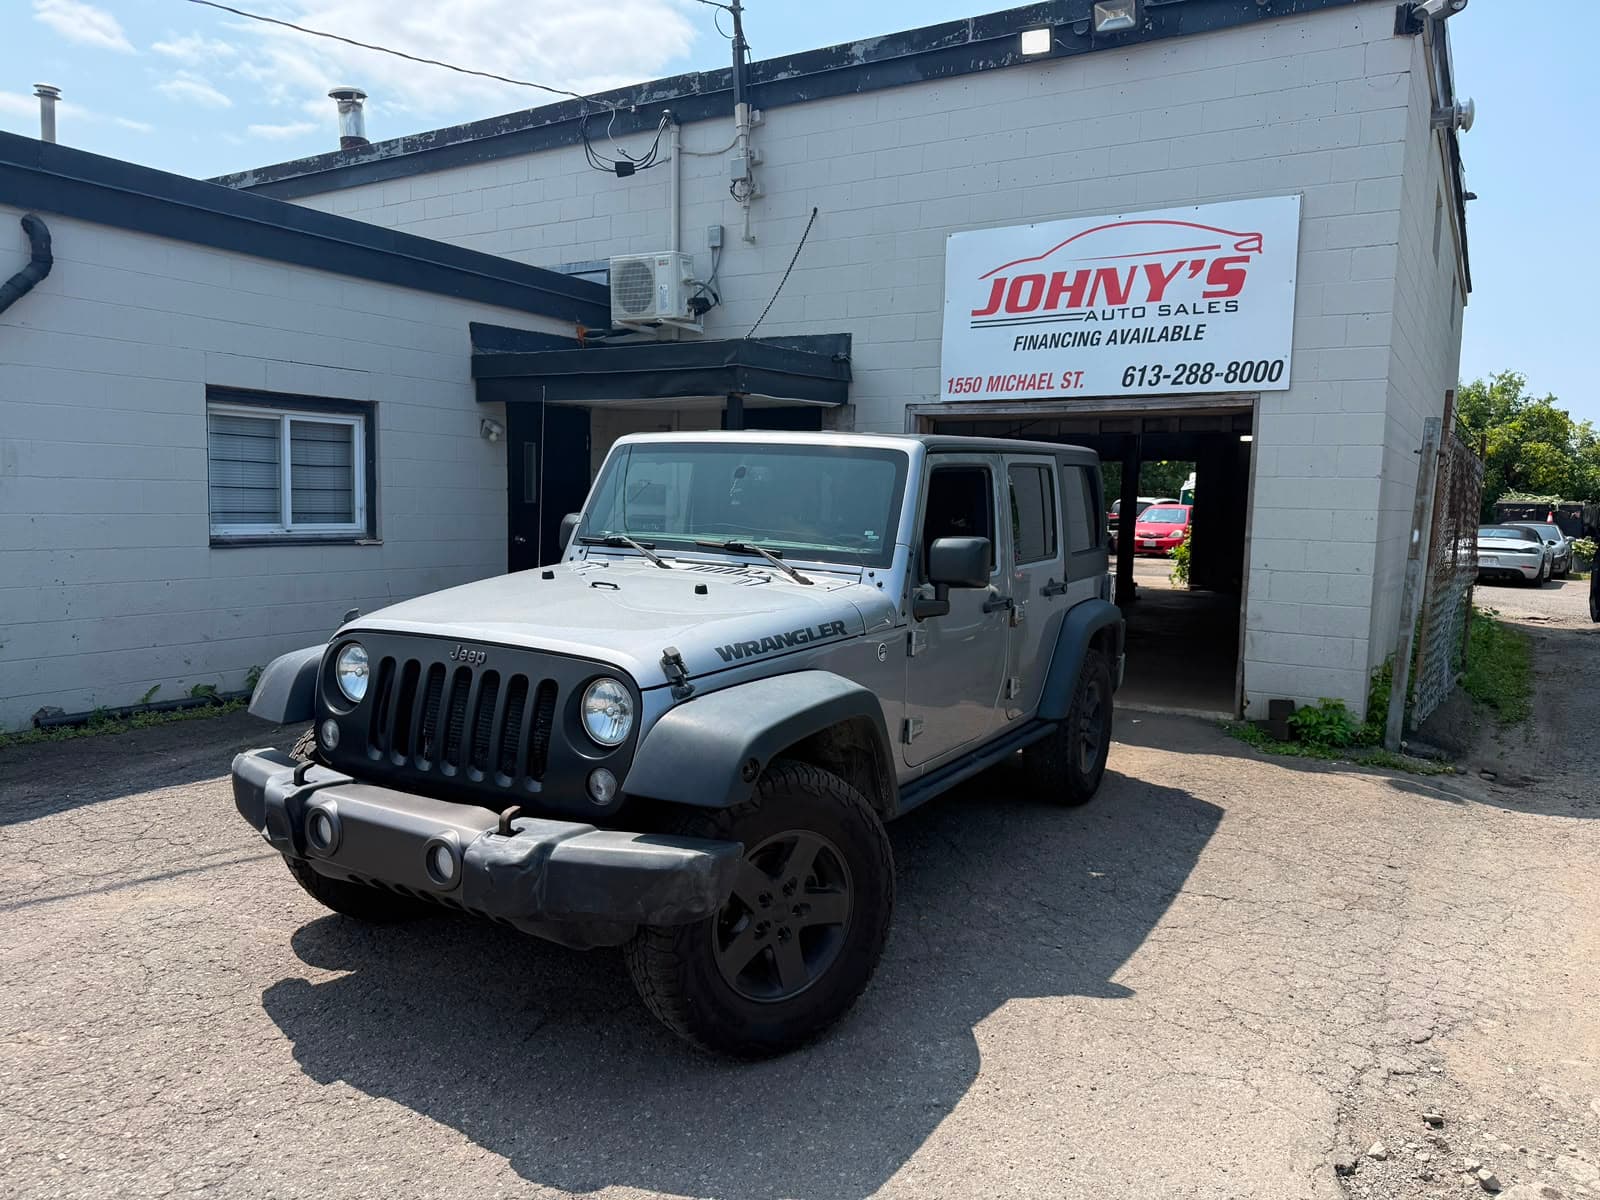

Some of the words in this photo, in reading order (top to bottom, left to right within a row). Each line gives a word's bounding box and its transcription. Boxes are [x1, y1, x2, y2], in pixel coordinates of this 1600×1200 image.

[971, 255, 1251, 317] JOHNY'S
[1084, 306, 1146, 322] AUTO
[1158, 300, 1239, 317] SALES
[1013, 330, 1102, 351] FINANCING
[1105, 323, 1207, 346] AVAILABLE
[947, 376, 983, 395] 1550
[986, 372, 1055, 393] MICHAEL
[1060, 371, 1085, 390] ST.
[1121, 359, 1284, 388] 613-288-8000
[714, 620, 848, 662] WRANGLER
[449, 644, 487, 667] Jeep
